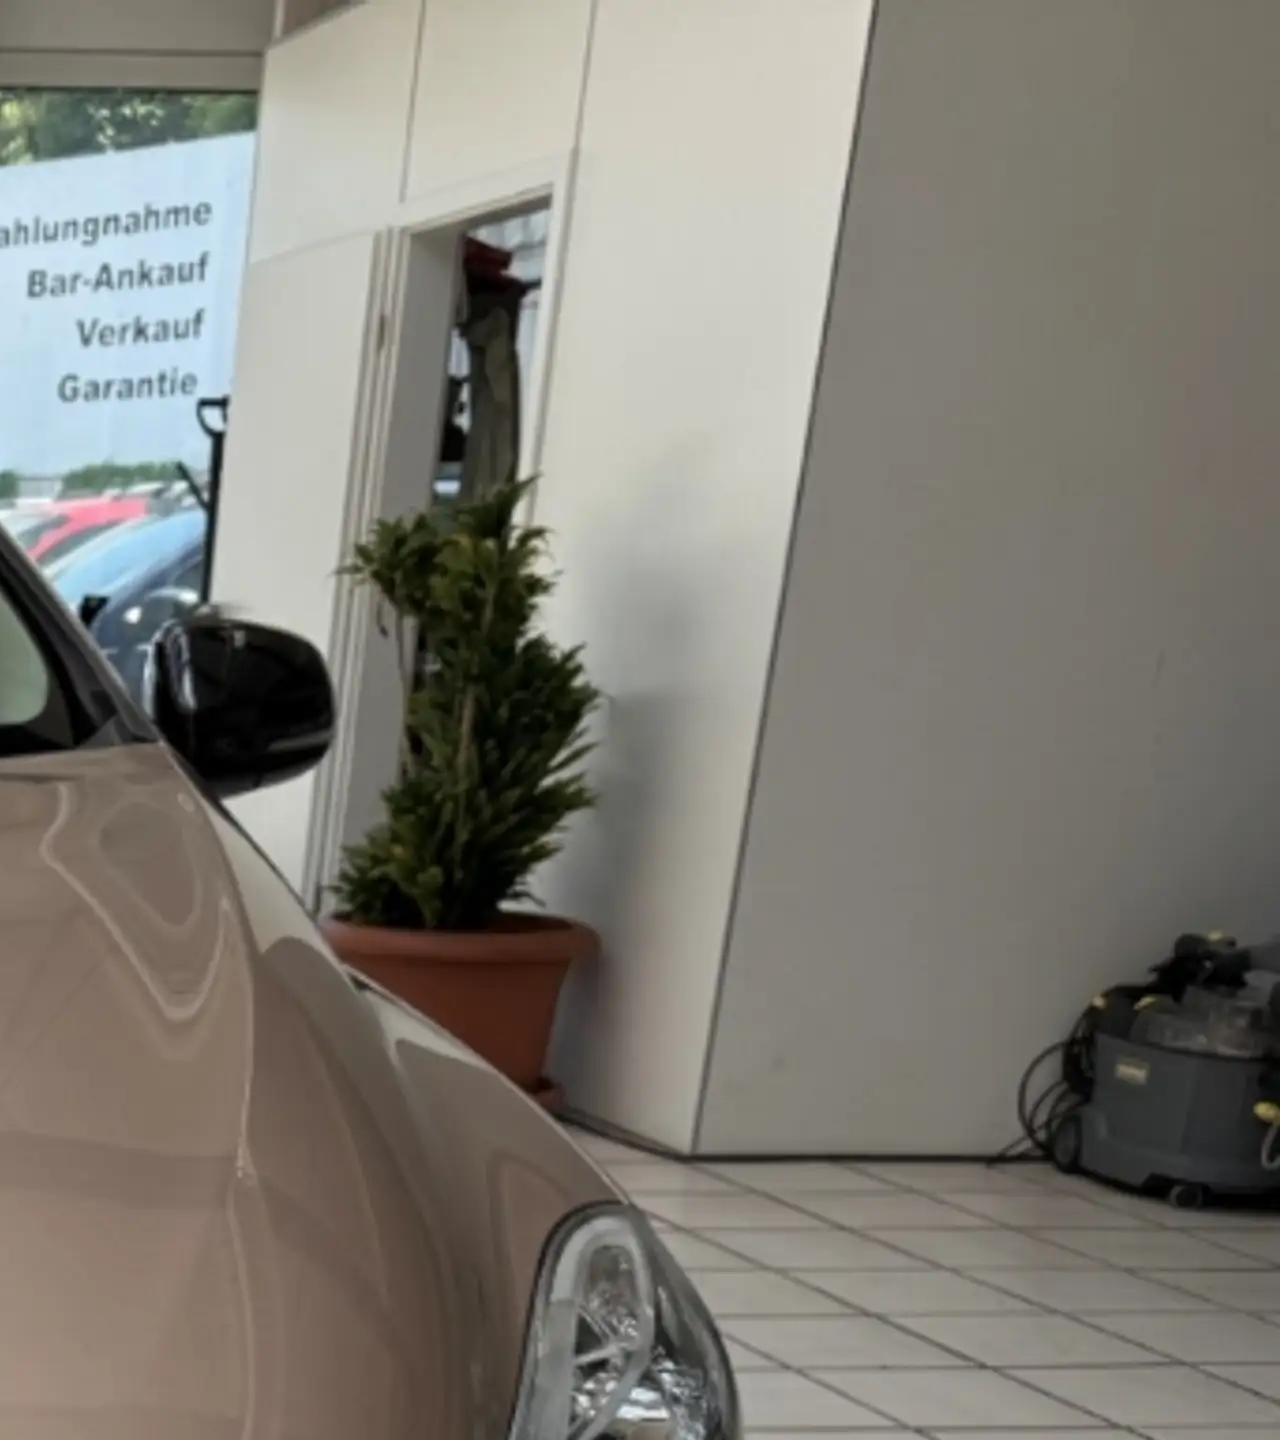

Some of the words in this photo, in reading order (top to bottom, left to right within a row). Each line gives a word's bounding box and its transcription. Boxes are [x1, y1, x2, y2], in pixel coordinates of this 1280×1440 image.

[27, 252, 209, 299] Bar-Ankauf
[77, 309, 205, 348] Verkauf
[57, 368, 198, 404] Garantie
